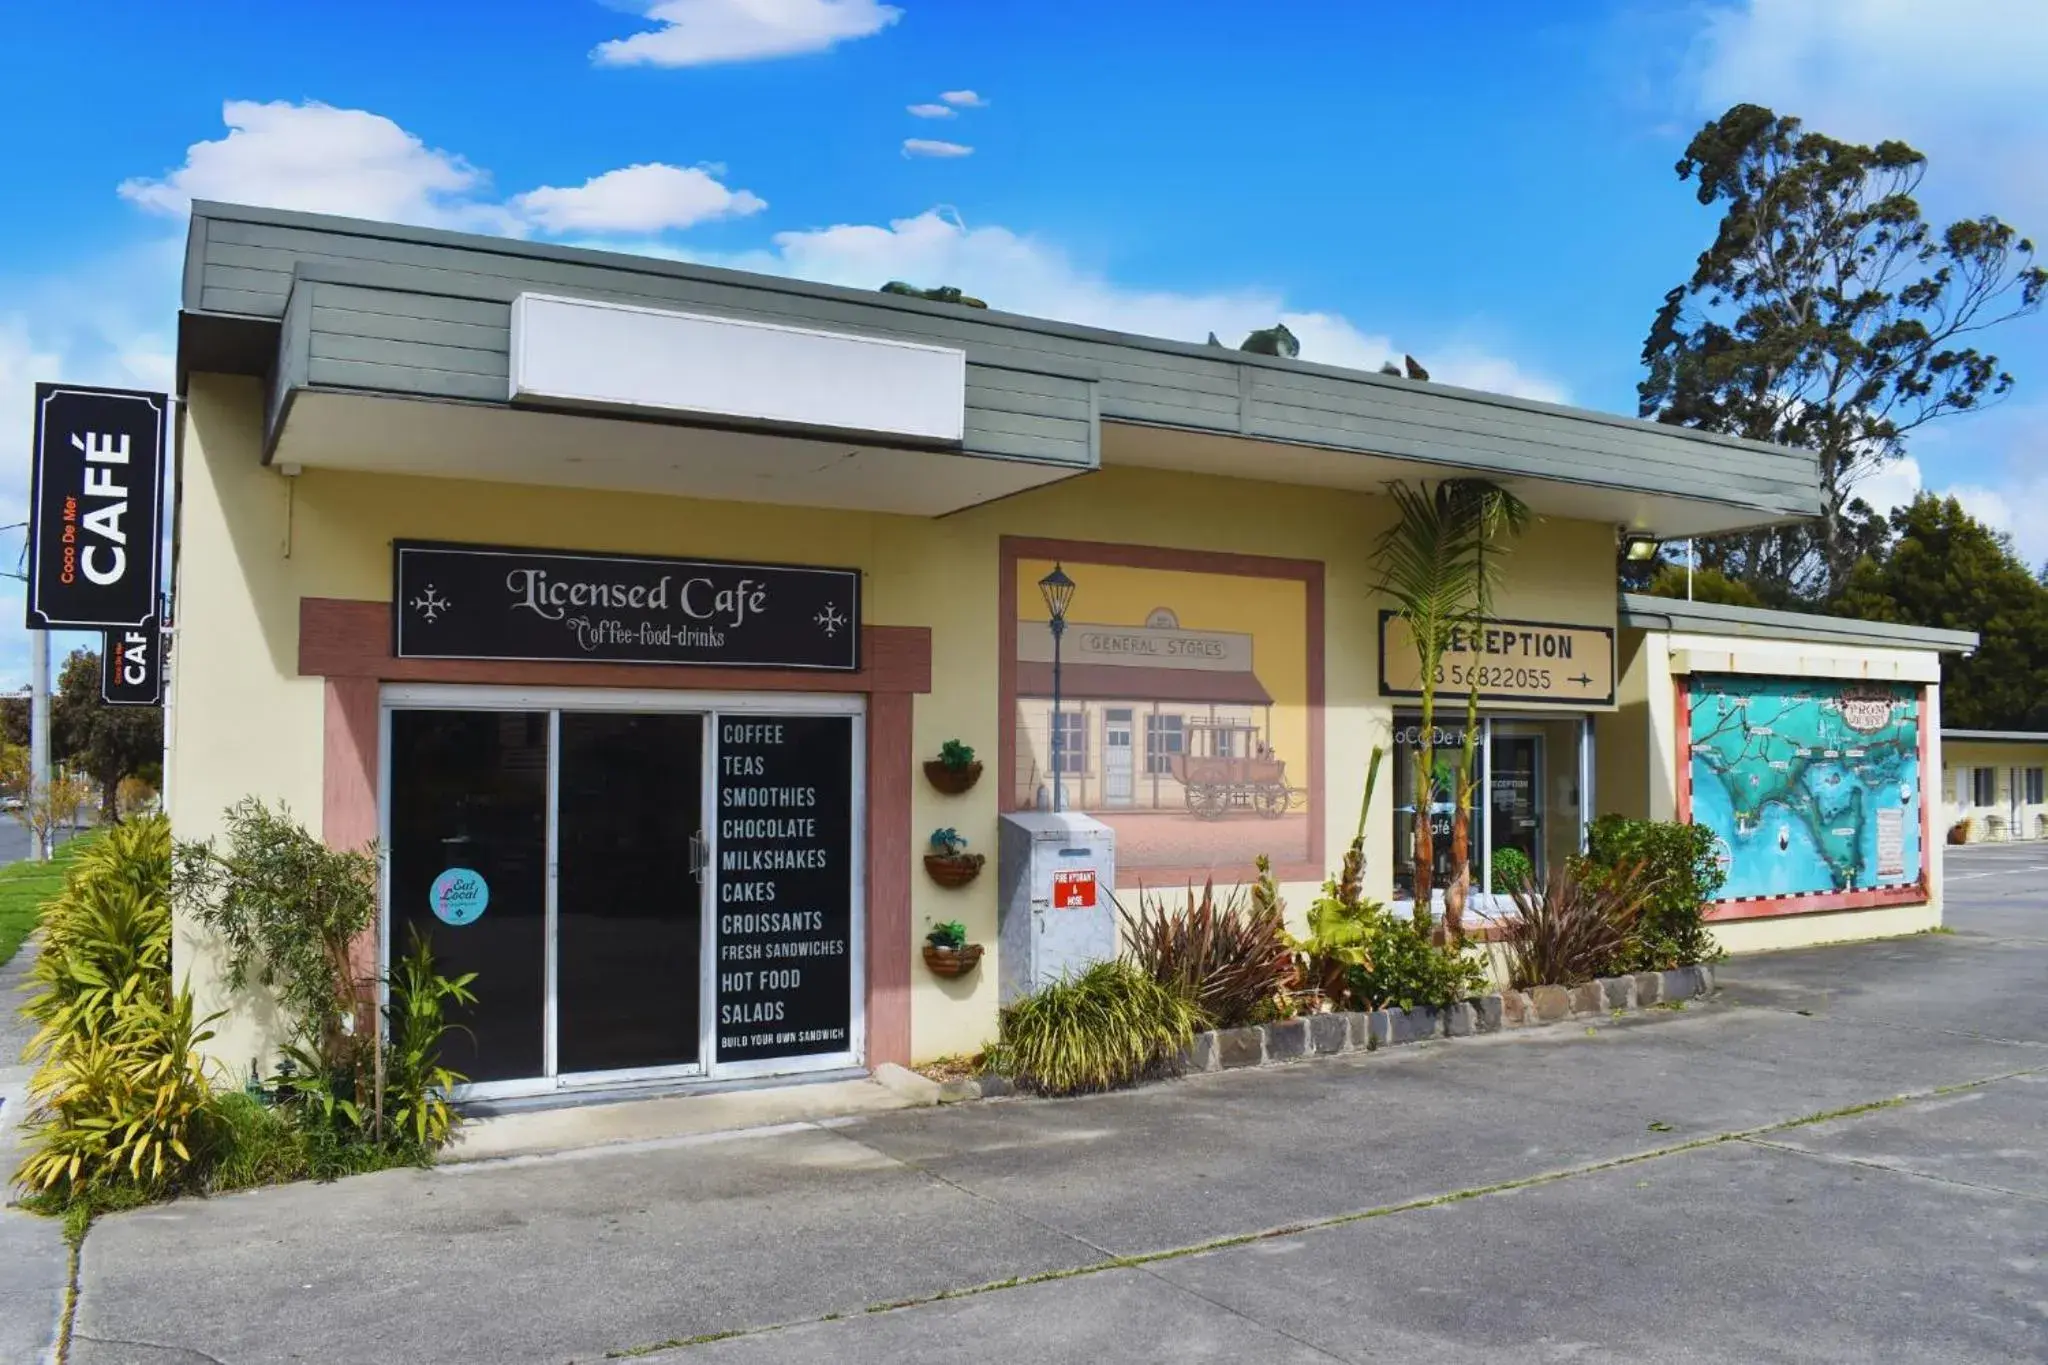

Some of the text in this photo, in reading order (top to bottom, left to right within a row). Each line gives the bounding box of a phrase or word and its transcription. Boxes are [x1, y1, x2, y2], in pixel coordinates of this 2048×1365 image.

[71, 431, 130, 586] CAFÉ
[61, 495, 77, 584] Coco De Mer
[506, 568, 768, 628] Licensed Café
[1091, 636, 1222, 656] GENERAL STORES
[124, 631, 147, 685] CAF
[1451, 664, 1551, 689] 56822055
[723, 724, 784, 744] COFFEE
[723, 756, 765, 776] TEAS
[1490, 780, 1529, 788] ECEPTION
[722, 787, 816, 807] SMOOTHIES
[722, 818, 816, 839] CHOCOLATE
[722, 849, 827, 871] MILKSHAKES
[440, 887, 479, 901] Local
[722, 882, 776, 903] CAKES
[722, 911, 823, 935] CROISSANTS
[722, 940, 844, 961] FRESH SANDWICHES
[722, 969, 801, 993] HOT FOOD
[721, 1001, 785, 1025] SALADS
[721, 1028, 845, 1049] BUILD YOUR OWN SANDWICH
